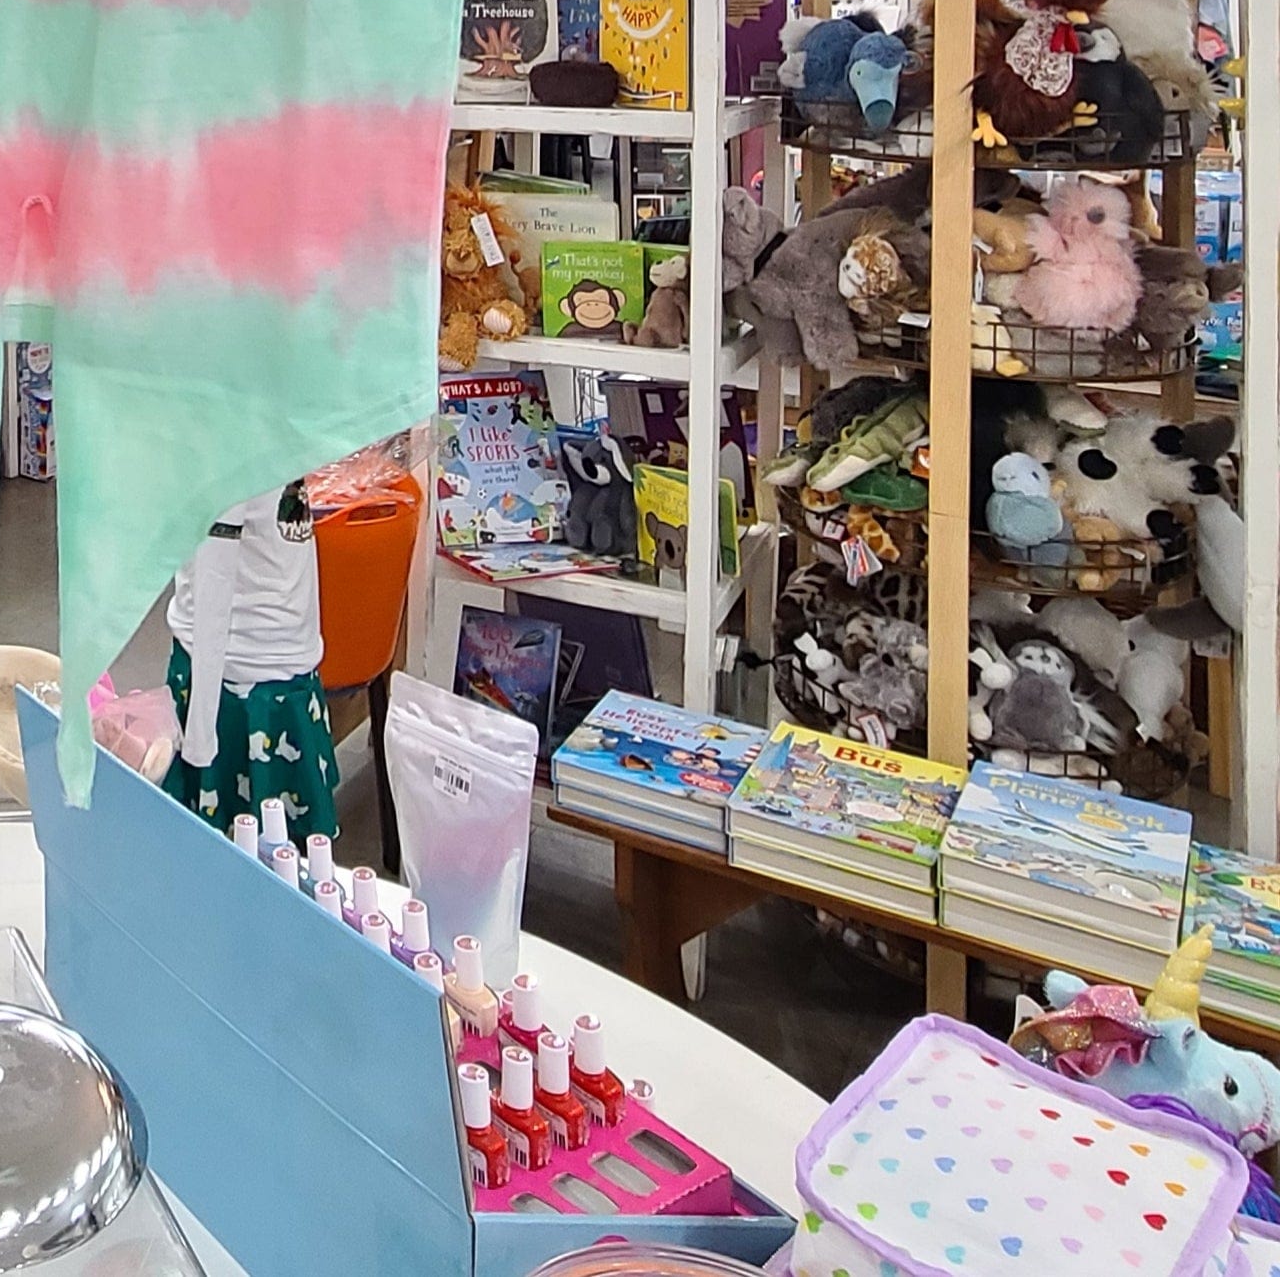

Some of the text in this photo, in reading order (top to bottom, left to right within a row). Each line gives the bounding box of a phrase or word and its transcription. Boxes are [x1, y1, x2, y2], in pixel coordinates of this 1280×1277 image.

[471, 3, 534, 18] Treehouse
[622, 5, 659, 27] HAPPY
[539, 208, 558, 218] The
[534, 220, 564, 232] Brave
[570, 222, 596, 234] Lion
[563, 253, 624, 268] That's not
[552, 269, 571, 281] my
[485, 384, 493, 394] A
[496, 381, 522, 394] JOB?
[470, 428, 475, 443] I
[467, 445, 520, 462] SPORTS
[485, 464, 503, 474] what
[601, 709, 705, 741] Helicopter
[631, 725, 677, 742] Book
[834, 746, 902, 773] Bus
[989, 775, 1078, 808] Plane
[1083, 801, 1165, 832] Book
